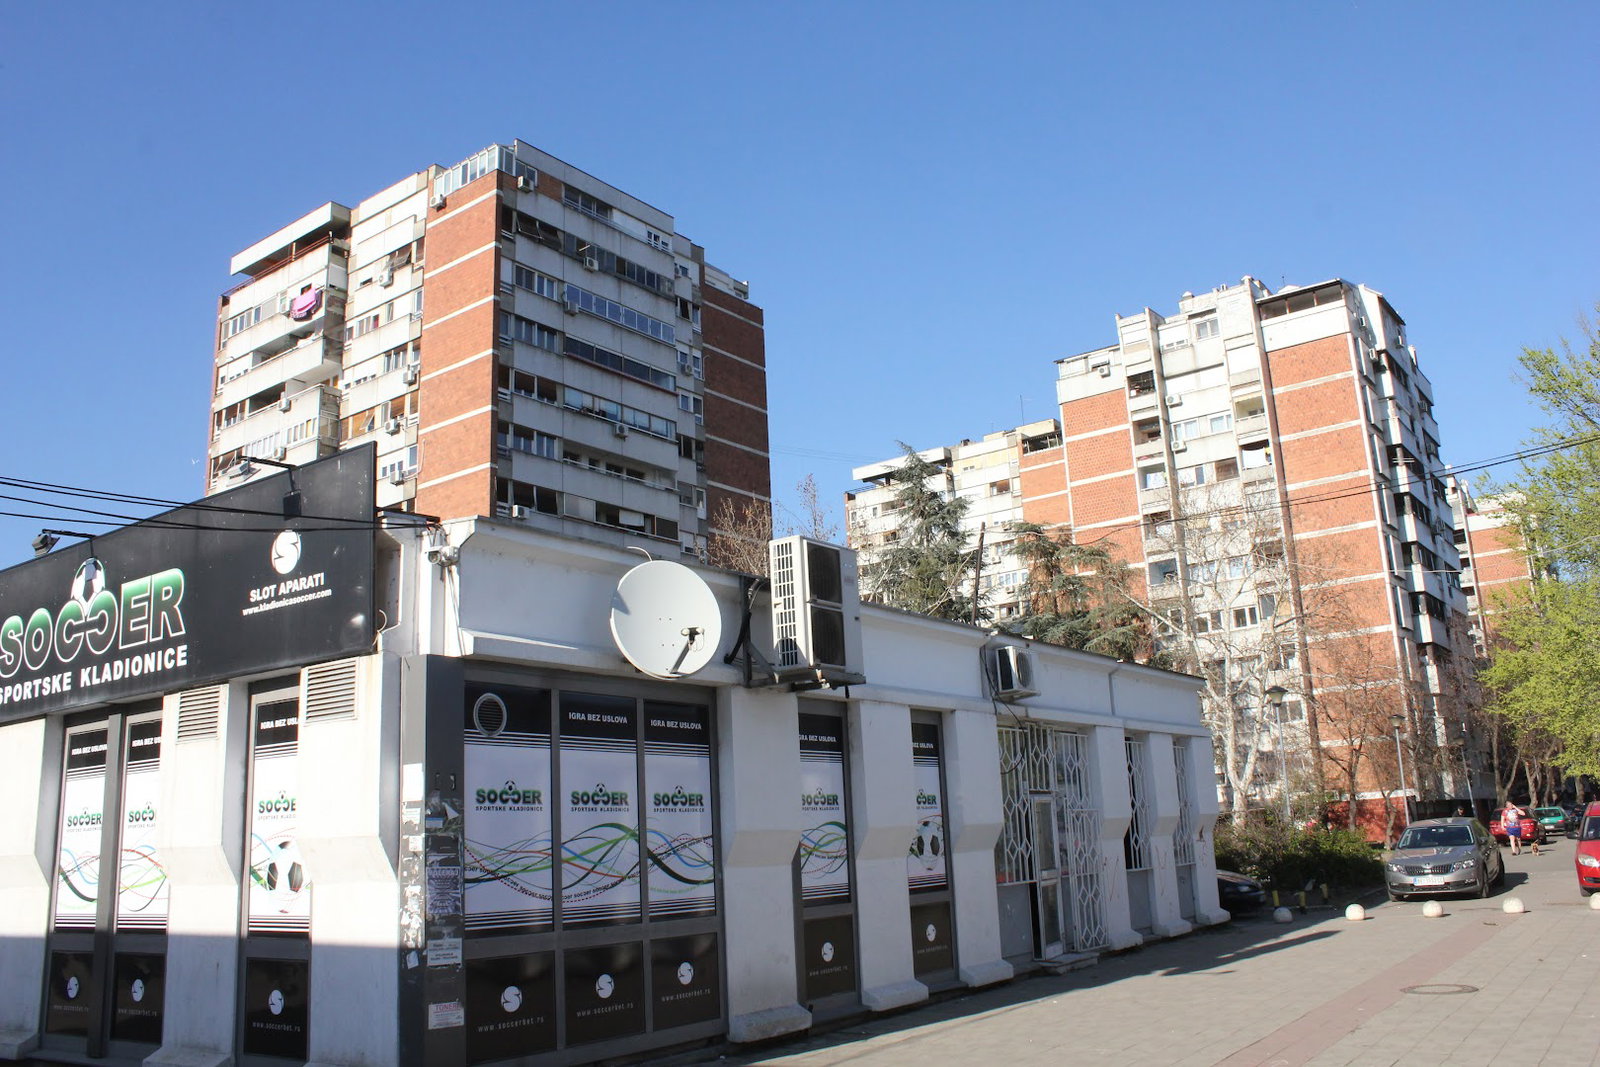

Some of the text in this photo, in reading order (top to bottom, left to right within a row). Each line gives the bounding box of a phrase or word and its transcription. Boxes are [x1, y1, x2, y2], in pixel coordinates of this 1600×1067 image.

[249, 572, 325, 602] SLOT APARATI
[242, 588, 332, 616] www.kladionicasoccer.com
[0, 568, 186, 678] SOCCER
[80, 644, 188, 687] KLADIONICE
[568, 711, 628, 724] IGRA BEZ USLOVA
[650, 719, 702, 730] IGRA BEZ USLOVA
[475, 788, 543, 804] SOCCER
[571, 791, 629, 806] SOCCER
[653, 793, 705, 807] SOCCER
[67, 813, 102, 827] SOCCER
